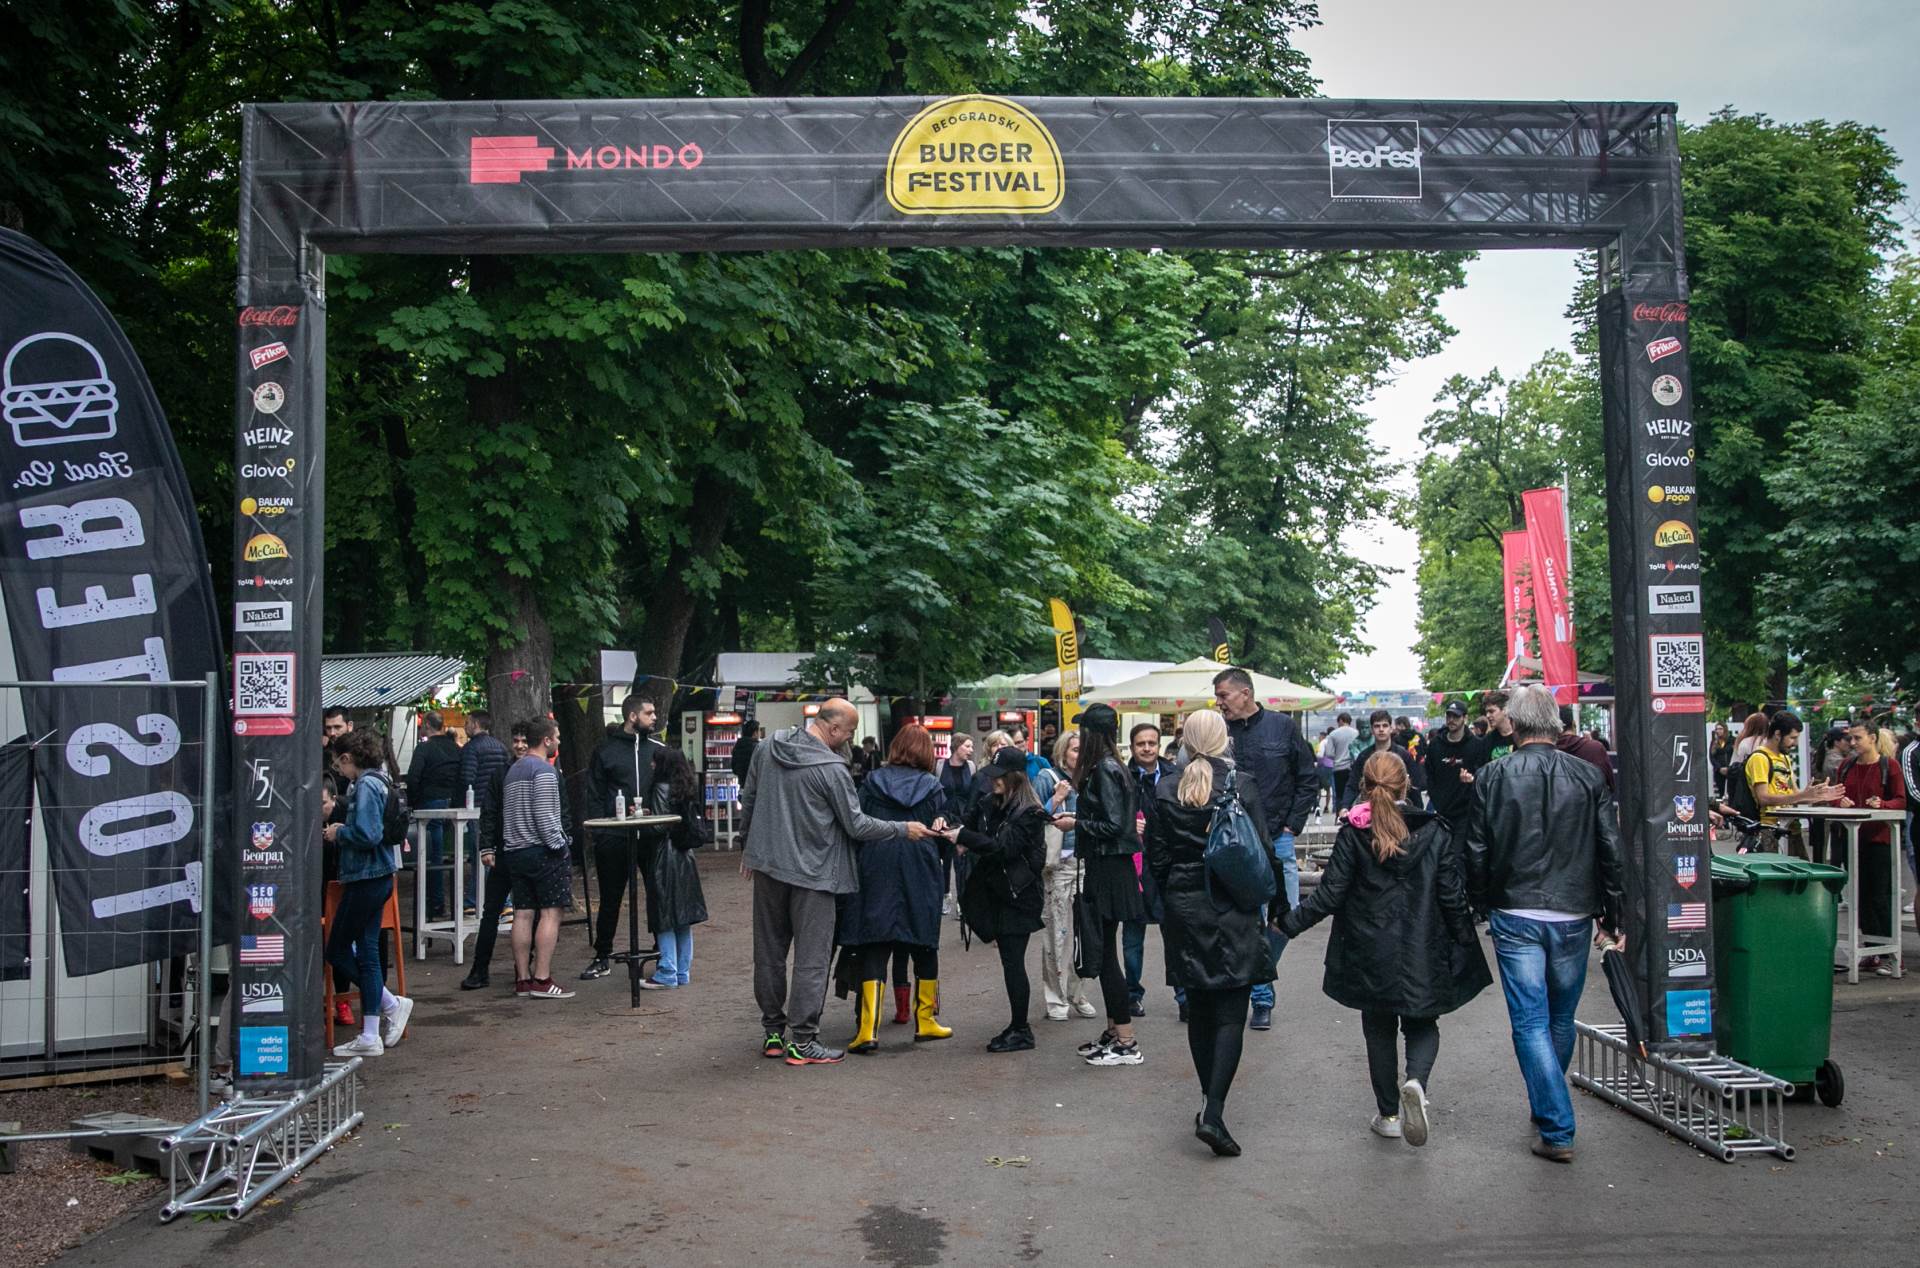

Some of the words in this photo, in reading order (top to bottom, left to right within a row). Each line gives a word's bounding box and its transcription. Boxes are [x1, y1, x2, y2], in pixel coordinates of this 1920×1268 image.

[930, 111, 1021, 134] BEOGRADSKI
[566, 142, 704, 170] MONDO
[919, 142, 1003, 164] BURGER
[1328, 145, 1423, 168] BeoFest
[908, 171, 1046, 193] FESTIVAL
[1646, 418, 1692, 436] HEINZ
[243, 427, 294, 446] HEINZ
[1646, 453, 1690, 466] Glovo
[241, 464, 288, 478] Glovo
[1665, 486, 1696, 494] BALKAN
[258, 497, 293, 507] BALKAN
[1666, 494, 1690, 502] FOOD
[258, 506, 285, 514] FOOD
[1659, 530, 1692, 544] McCain
[248, 544, 284, 558] McCain
[1660, 593, 1692, 604] Naked
[246, 610, 280, 621] Naked
[243, 848, 284, 865] Београд
[252, 886, 273, 897] БЕО
[1668, 948, 1706, 961] USDA
[242, 983, 283, 997] USDA
[1682, 1008, 1706, 1016] media
[1684, 1016, 1707, 1025] group
[260, 1036, 283, 1045] adria
[257, 1044, 283, 1053] media
[258, 1054, 283, 1064] group
